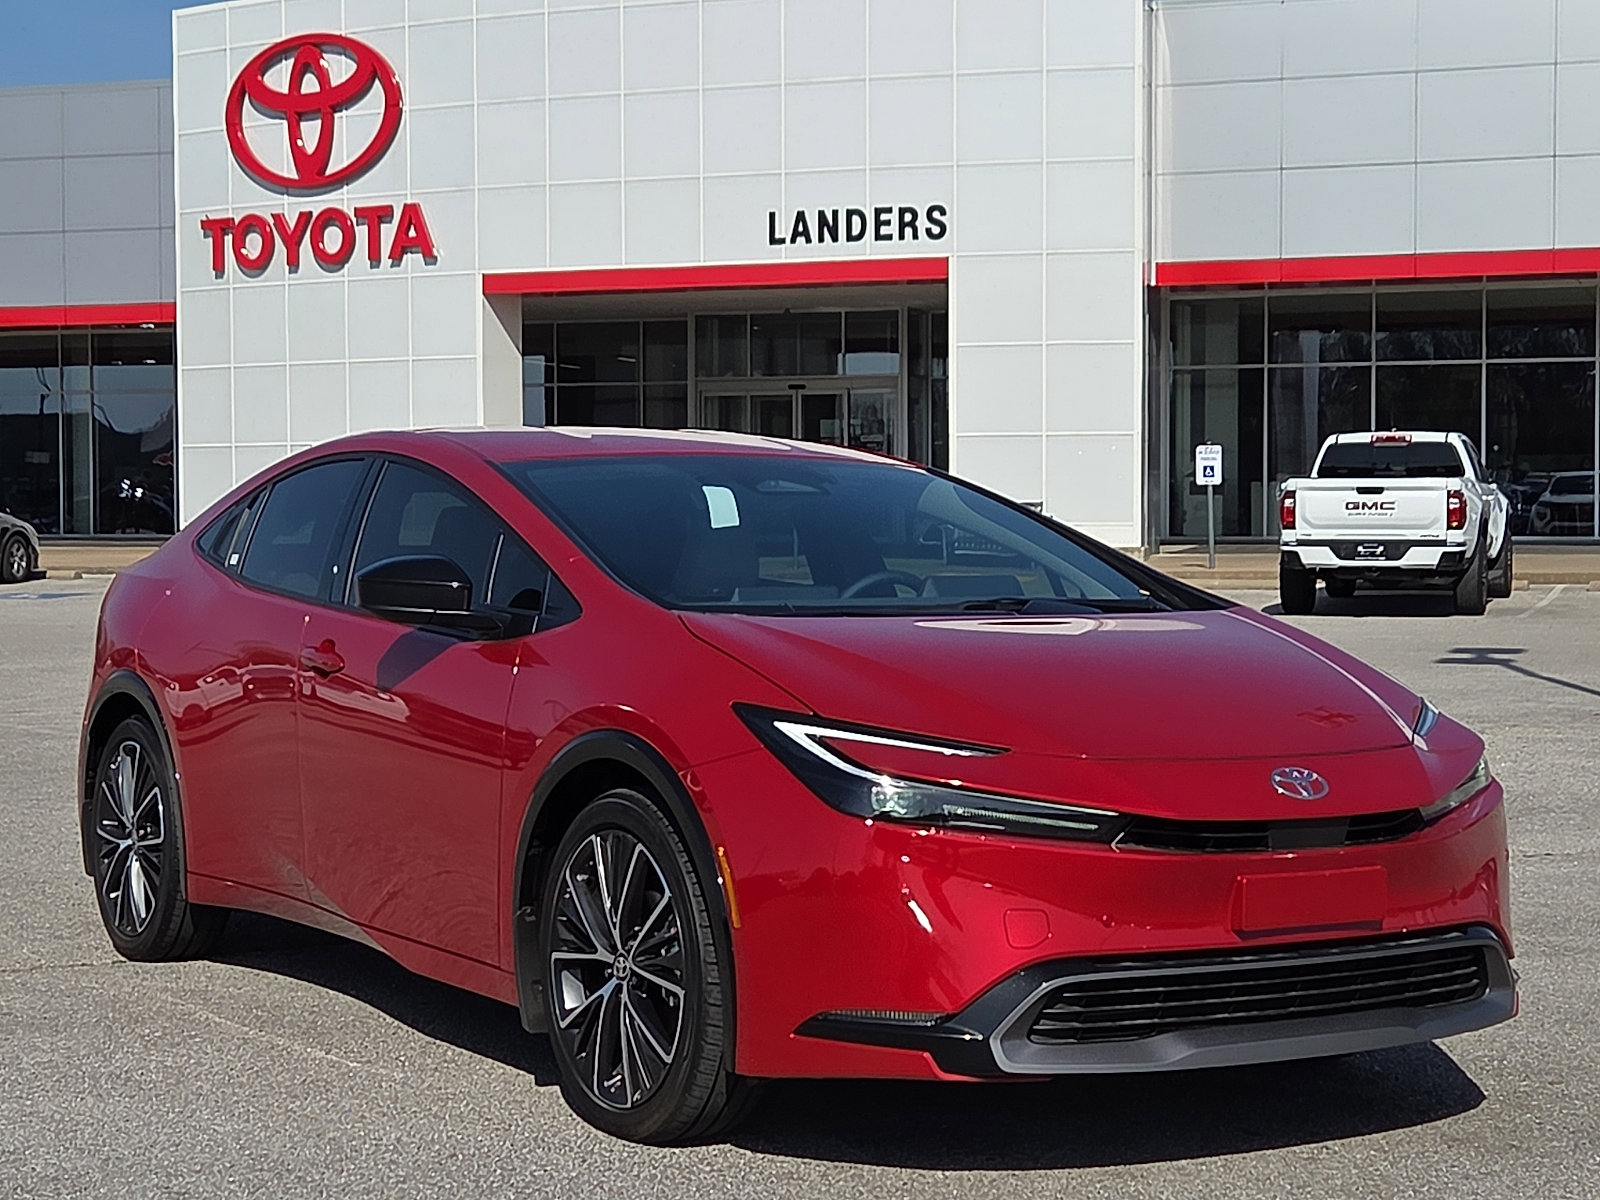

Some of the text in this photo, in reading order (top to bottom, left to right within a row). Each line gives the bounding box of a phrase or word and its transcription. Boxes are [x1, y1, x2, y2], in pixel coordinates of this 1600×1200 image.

[200, 202, 438, 279] TOYOTA
[768, 204, 948, 246] LANDERS
[1345, 501, 1396, 511] GMC
